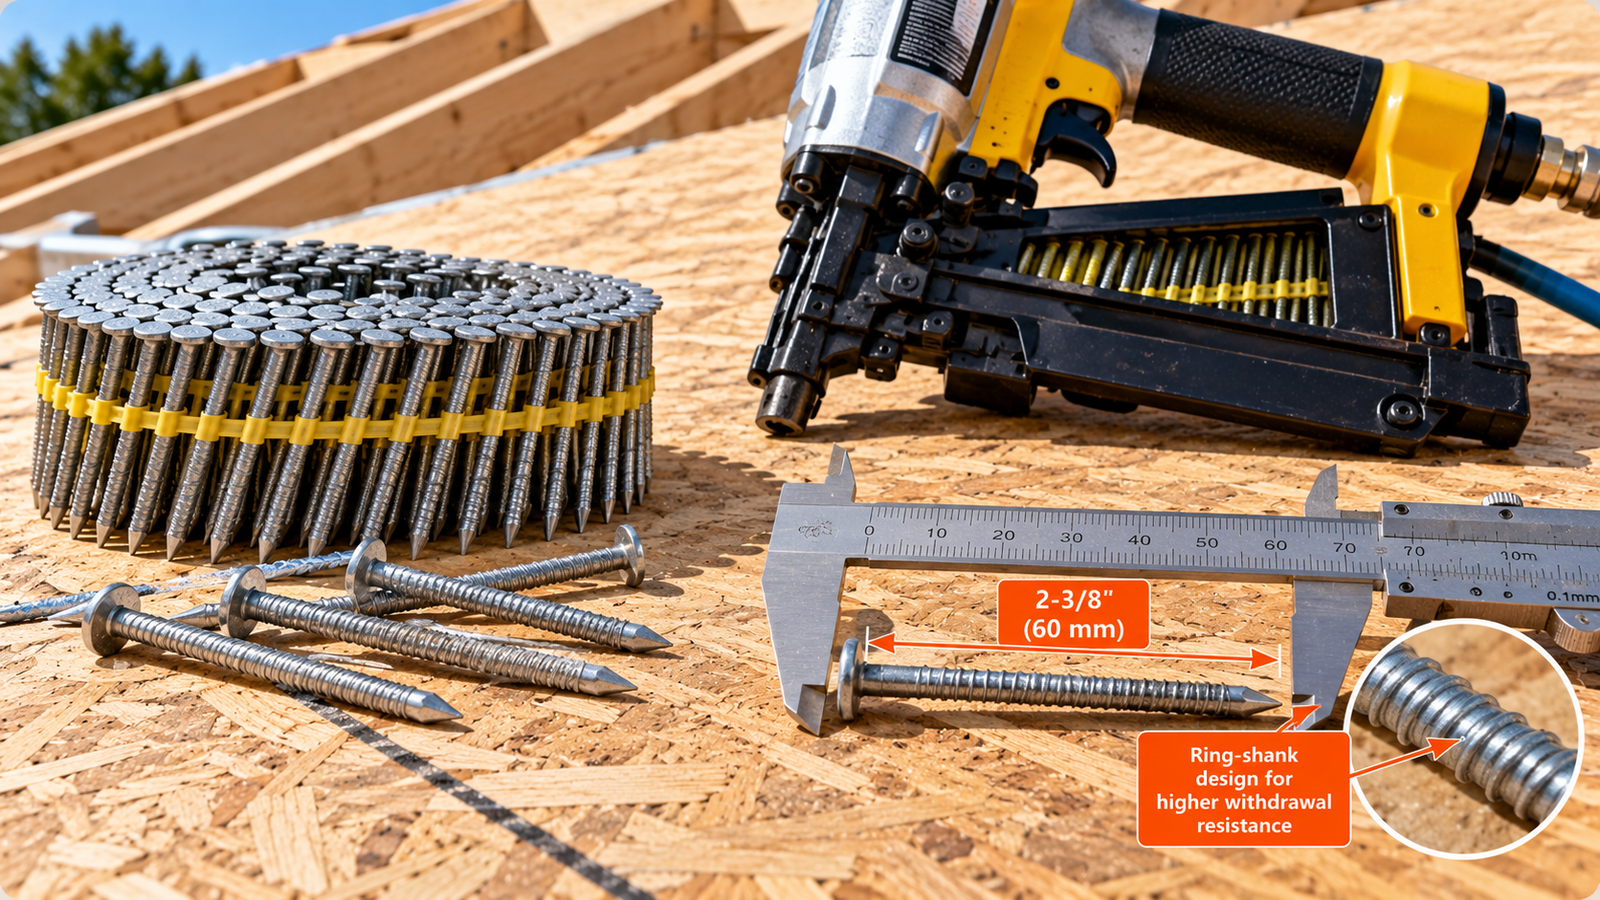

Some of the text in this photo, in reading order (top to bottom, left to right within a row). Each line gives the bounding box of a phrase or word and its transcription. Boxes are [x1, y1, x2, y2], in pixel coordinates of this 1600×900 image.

[864, 525, 1356, 554] 0 10 20 30 40 50 60 70
[1403, 545, 1425, 557] 70
[1547, 590, 1600, 603] 0.1mm
